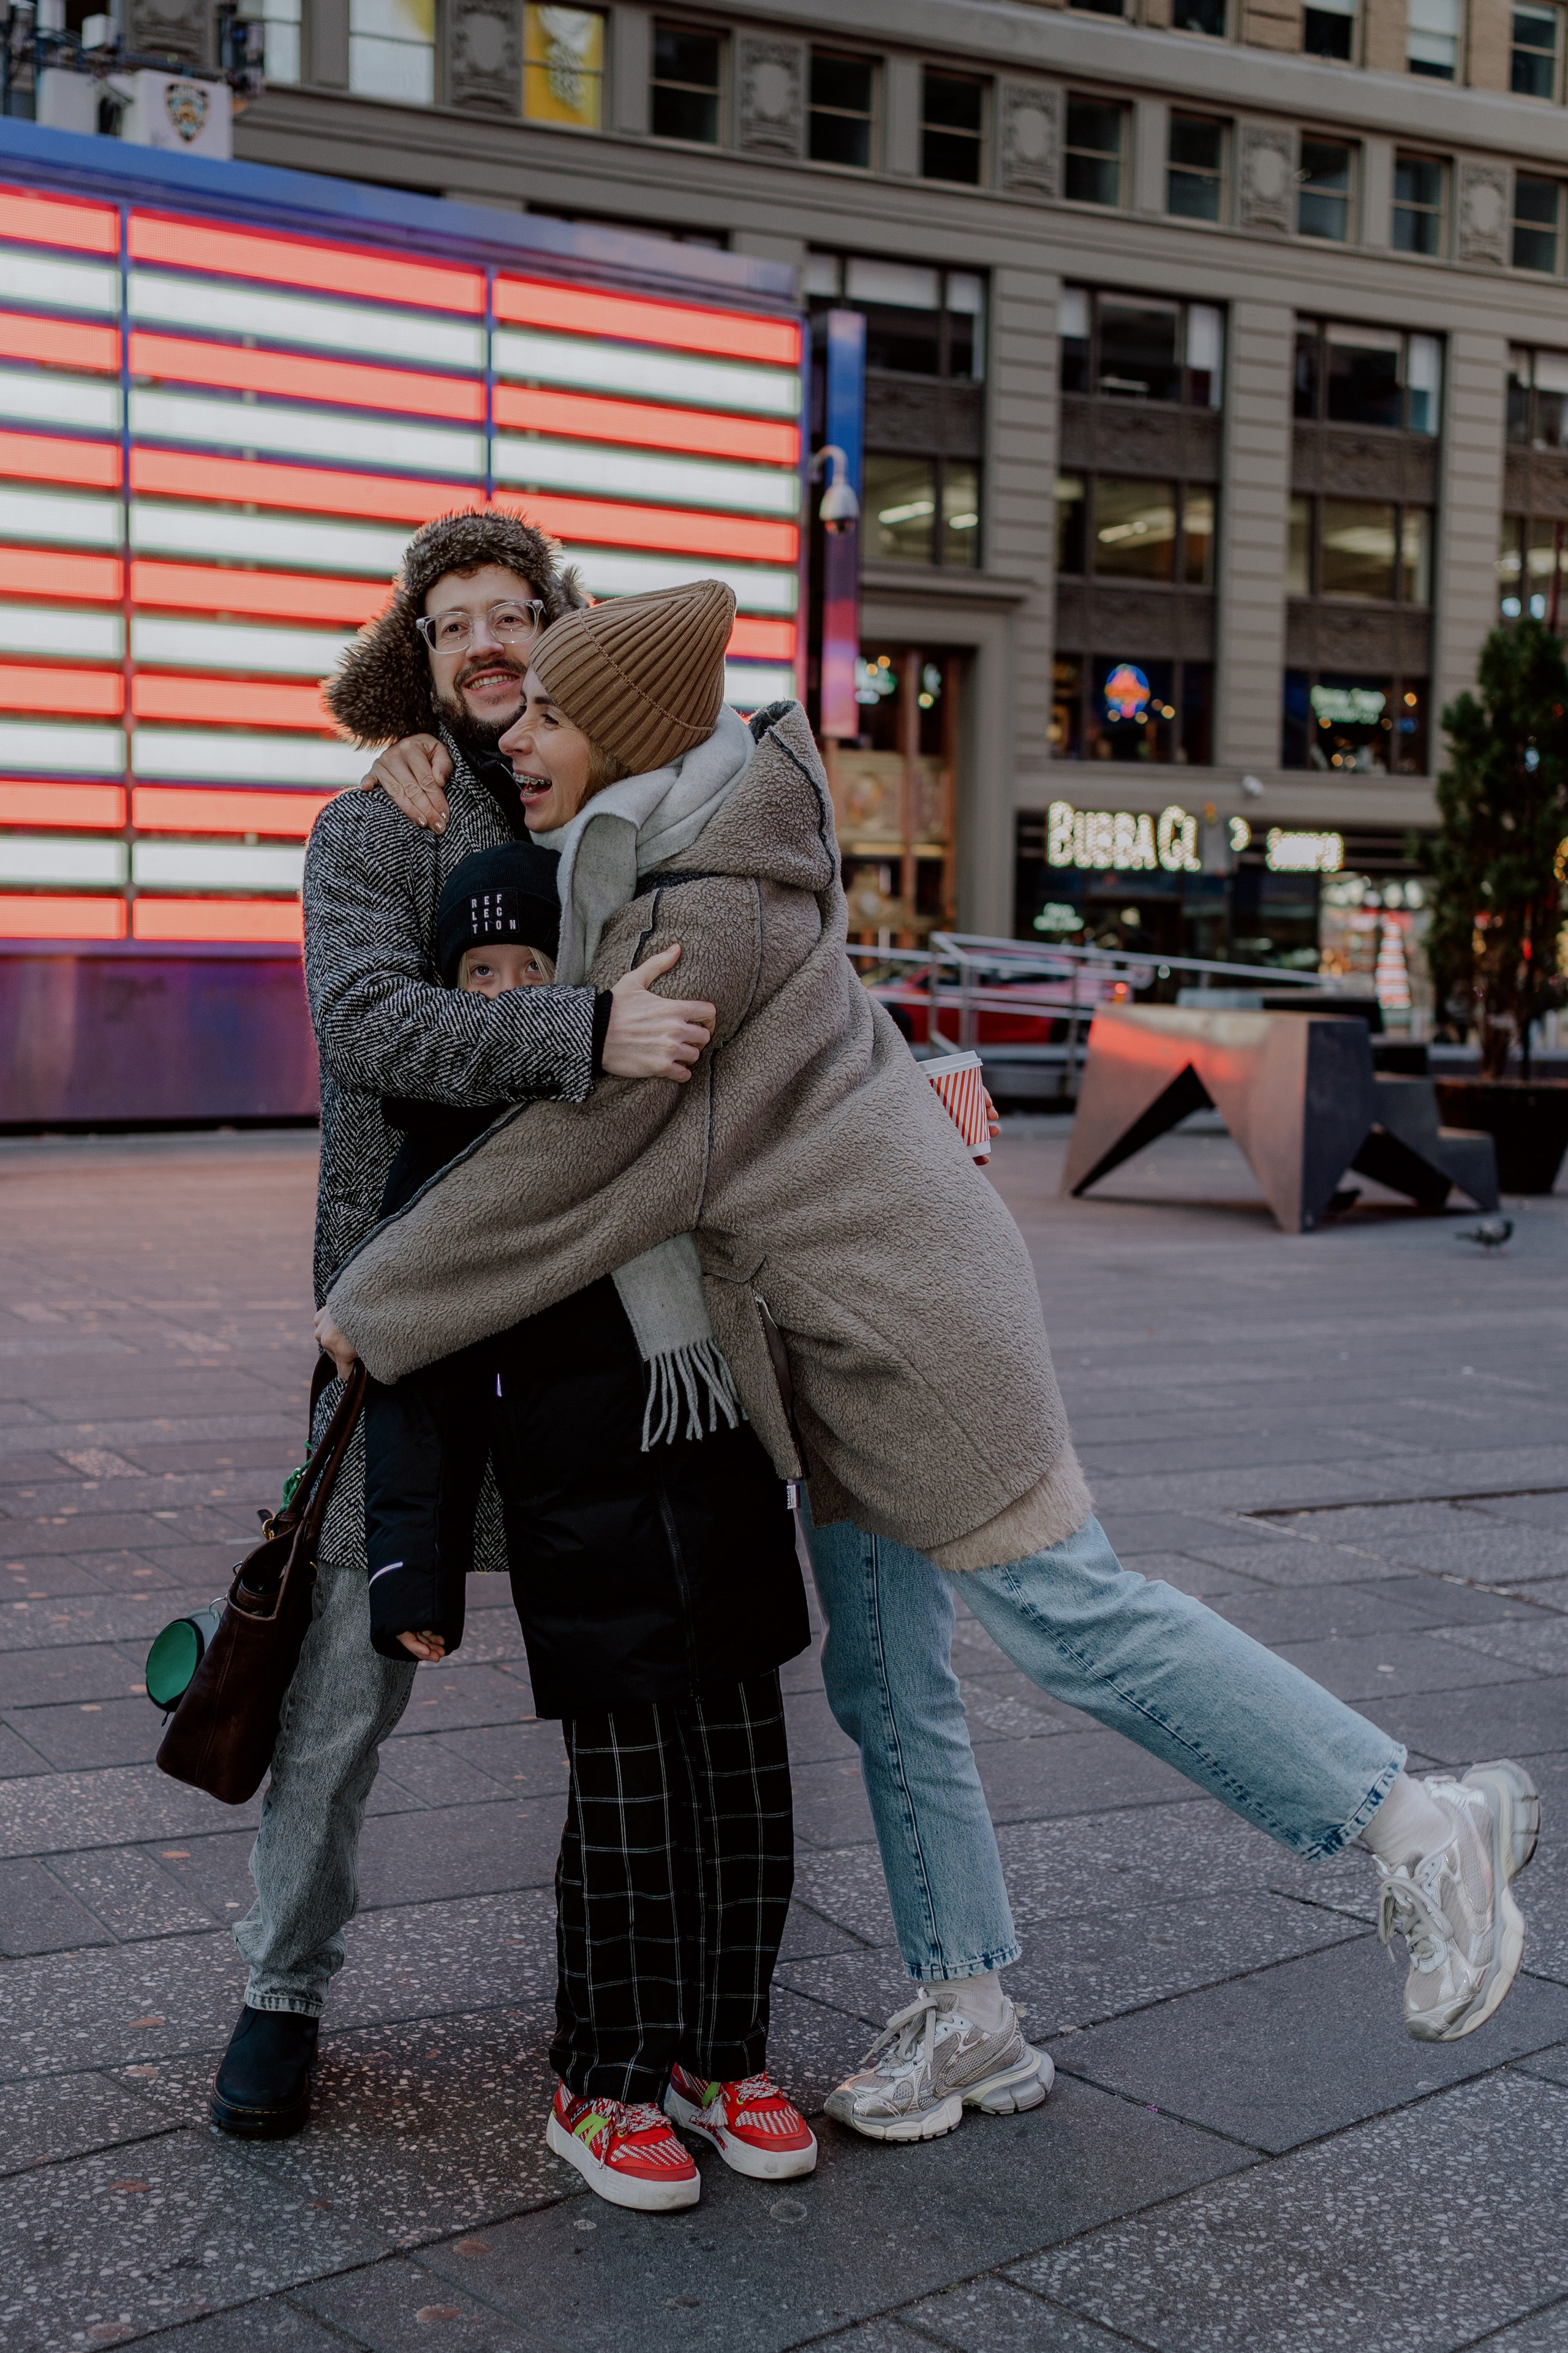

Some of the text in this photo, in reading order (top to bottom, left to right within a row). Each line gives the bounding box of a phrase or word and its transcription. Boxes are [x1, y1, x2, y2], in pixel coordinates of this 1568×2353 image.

[471, 894, 502, 908] REF
[472, 907, 502, 921] LEC
[472, 920, 516, 934] TION
